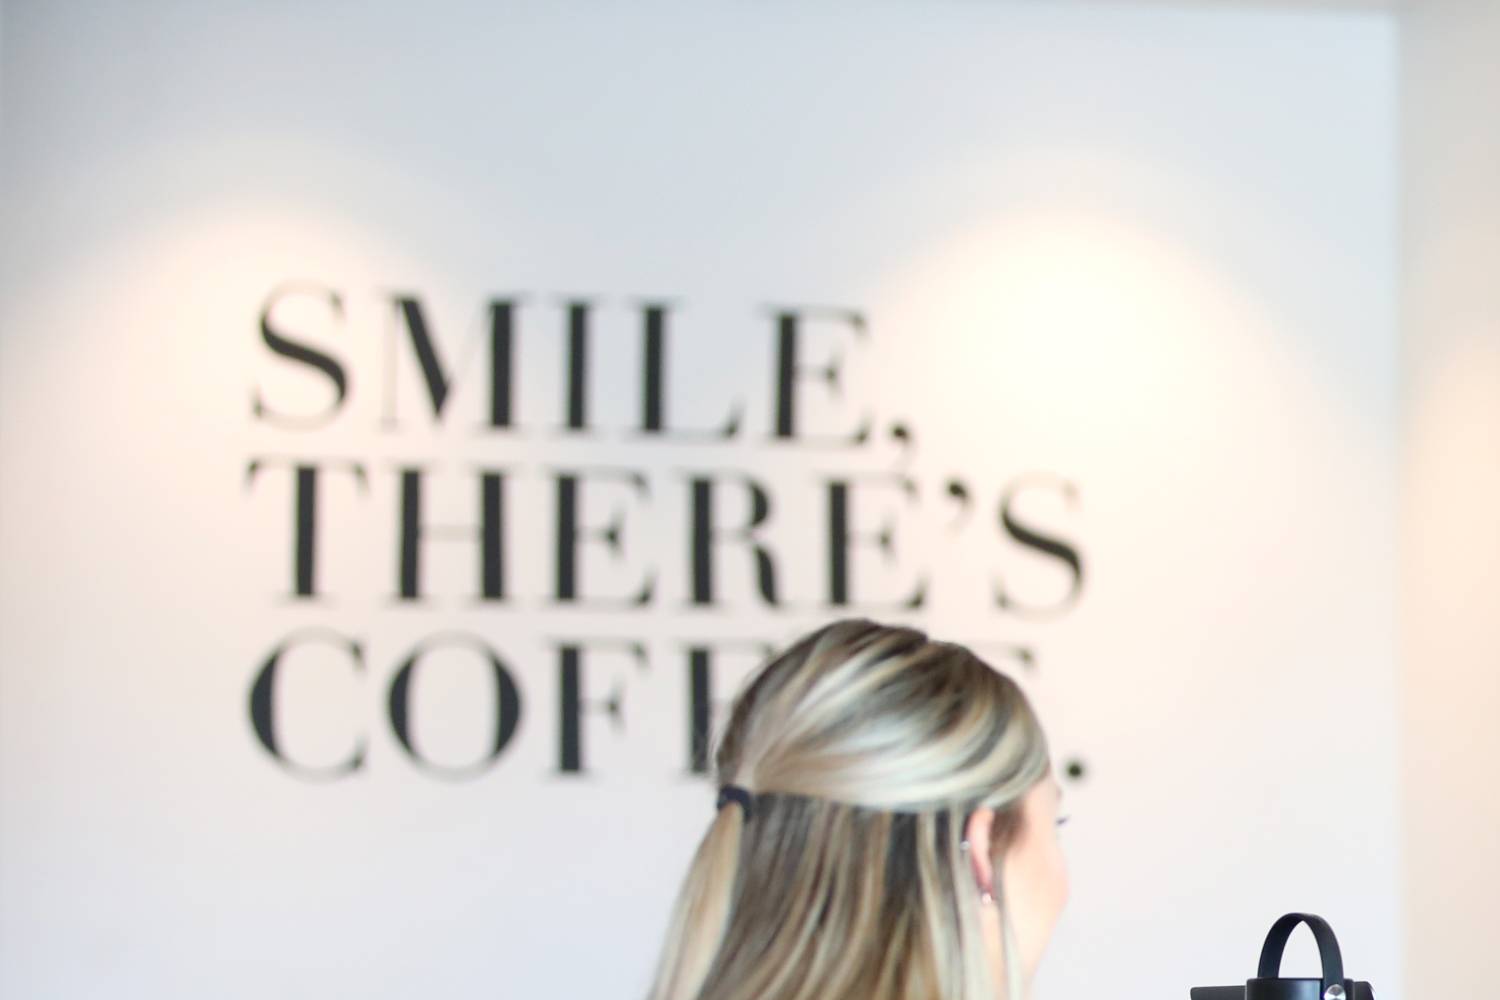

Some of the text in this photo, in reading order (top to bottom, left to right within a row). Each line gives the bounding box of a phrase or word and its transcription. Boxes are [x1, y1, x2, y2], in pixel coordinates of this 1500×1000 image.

[251, 281, 914, 466] SMILE,
[242, 455, 1088, 618] THERE'S
[246, 627, 1085, 784] COFF.
